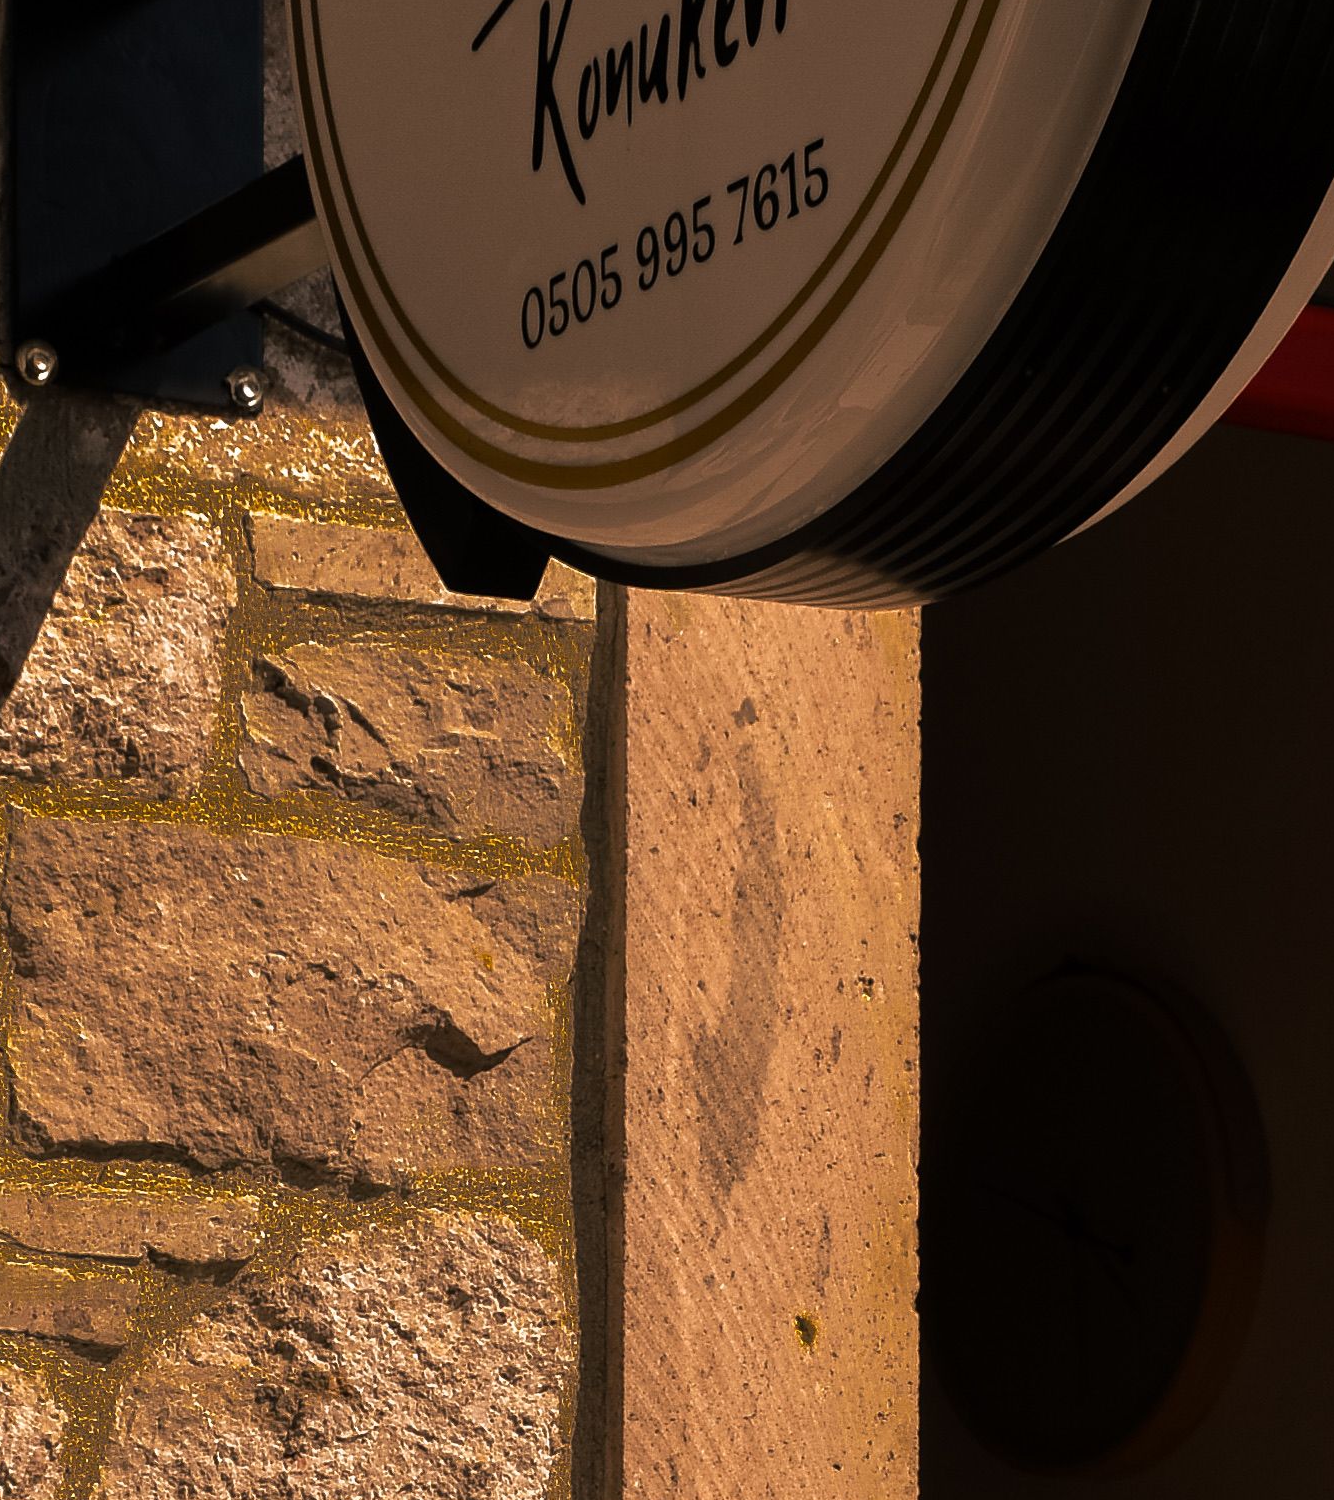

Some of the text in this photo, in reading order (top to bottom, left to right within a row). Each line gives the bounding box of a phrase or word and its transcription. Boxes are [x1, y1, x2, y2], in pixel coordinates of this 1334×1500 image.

[520, 136, 830, 351] 0505 995 7615
